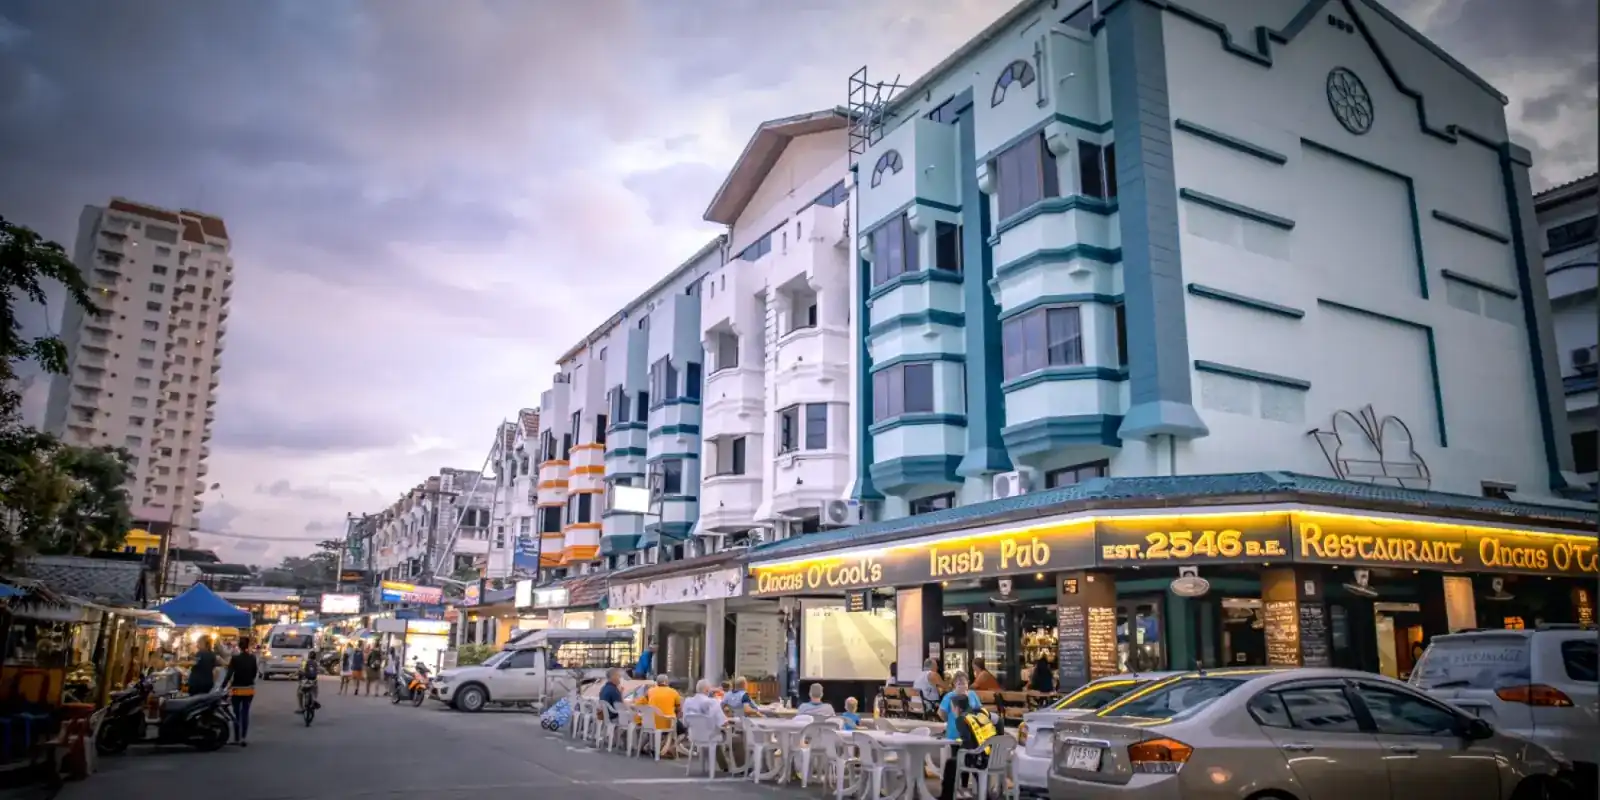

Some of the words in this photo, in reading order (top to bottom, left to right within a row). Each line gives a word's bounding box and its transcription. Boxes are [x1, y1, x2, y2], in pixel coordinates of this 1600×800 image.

[1000, 536, 1051, 569] Pub
[1102, 544, 1145, 560] EST.
[1145, 530, 1243, 560] 2546
[1245, 540, 1286, 556] B.E.
